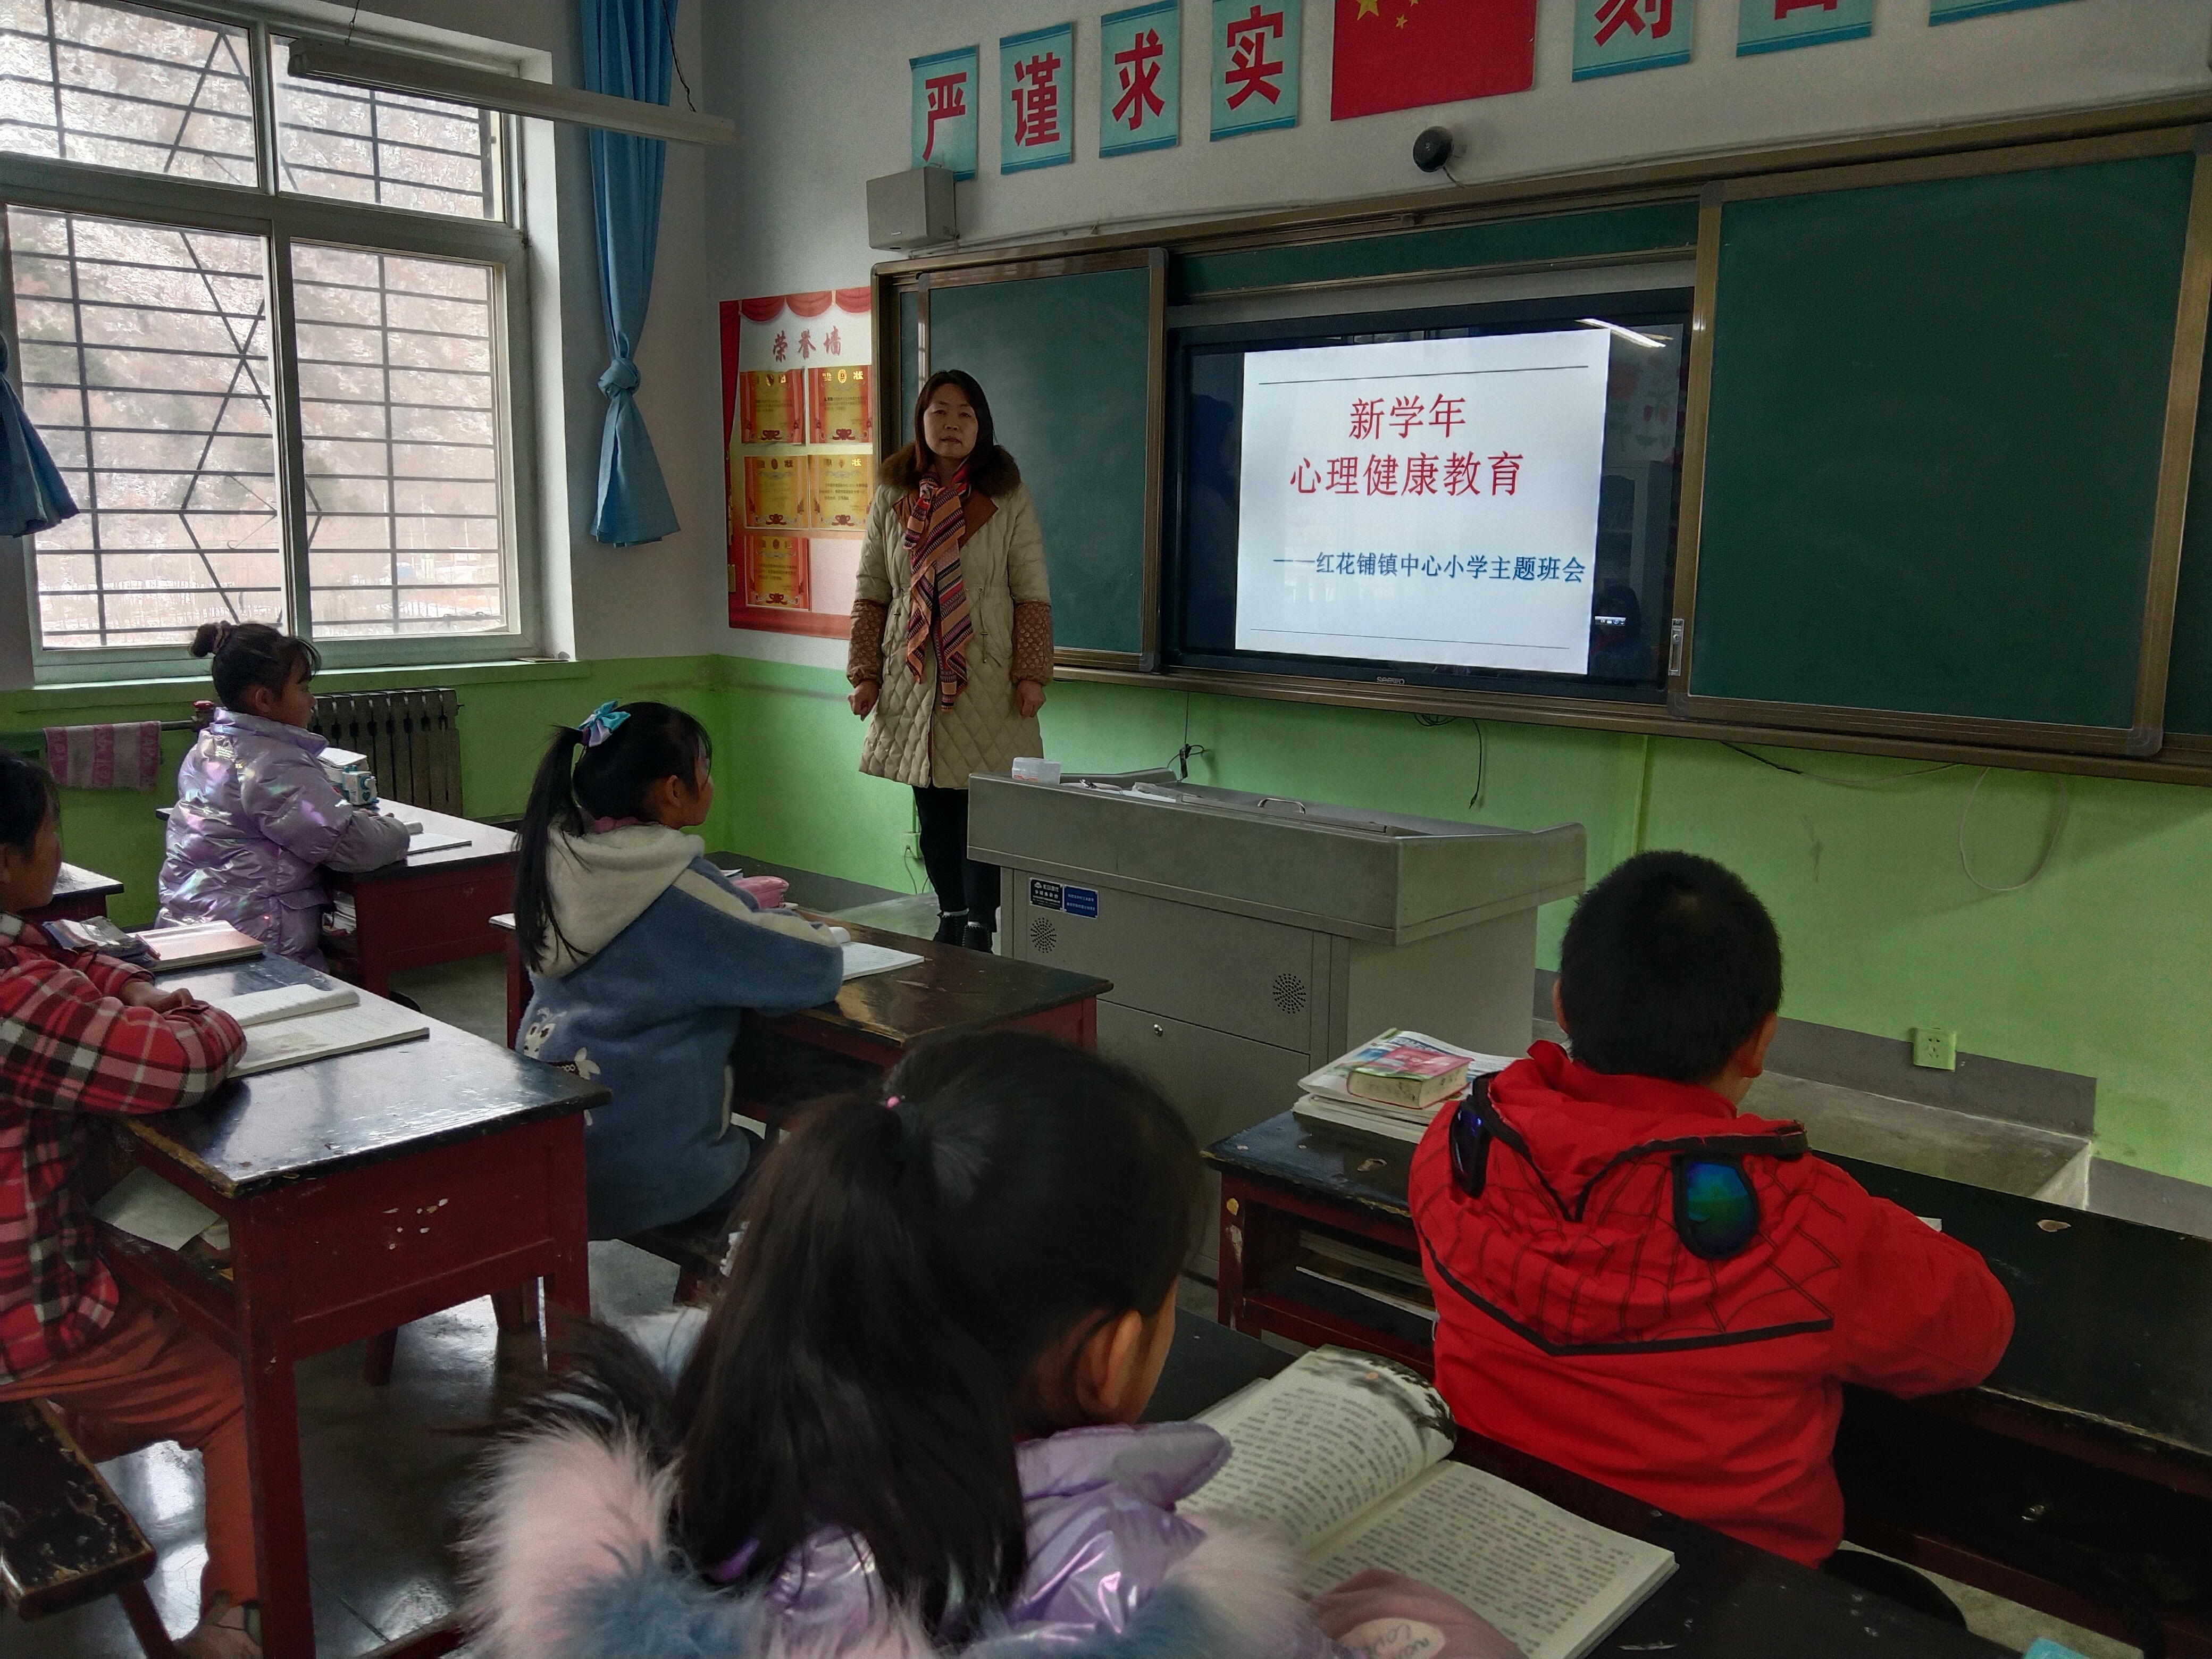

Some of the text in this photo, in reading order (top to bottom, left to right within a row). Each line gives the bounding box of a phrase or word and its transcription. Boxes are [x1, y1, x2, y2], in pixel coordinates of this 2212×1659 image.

[921, 5, 1284, 162] 严谨求实
[1348, 393, 1466, 440] 新学年
[1290, 450, 1523, 496] 心理健康教育
